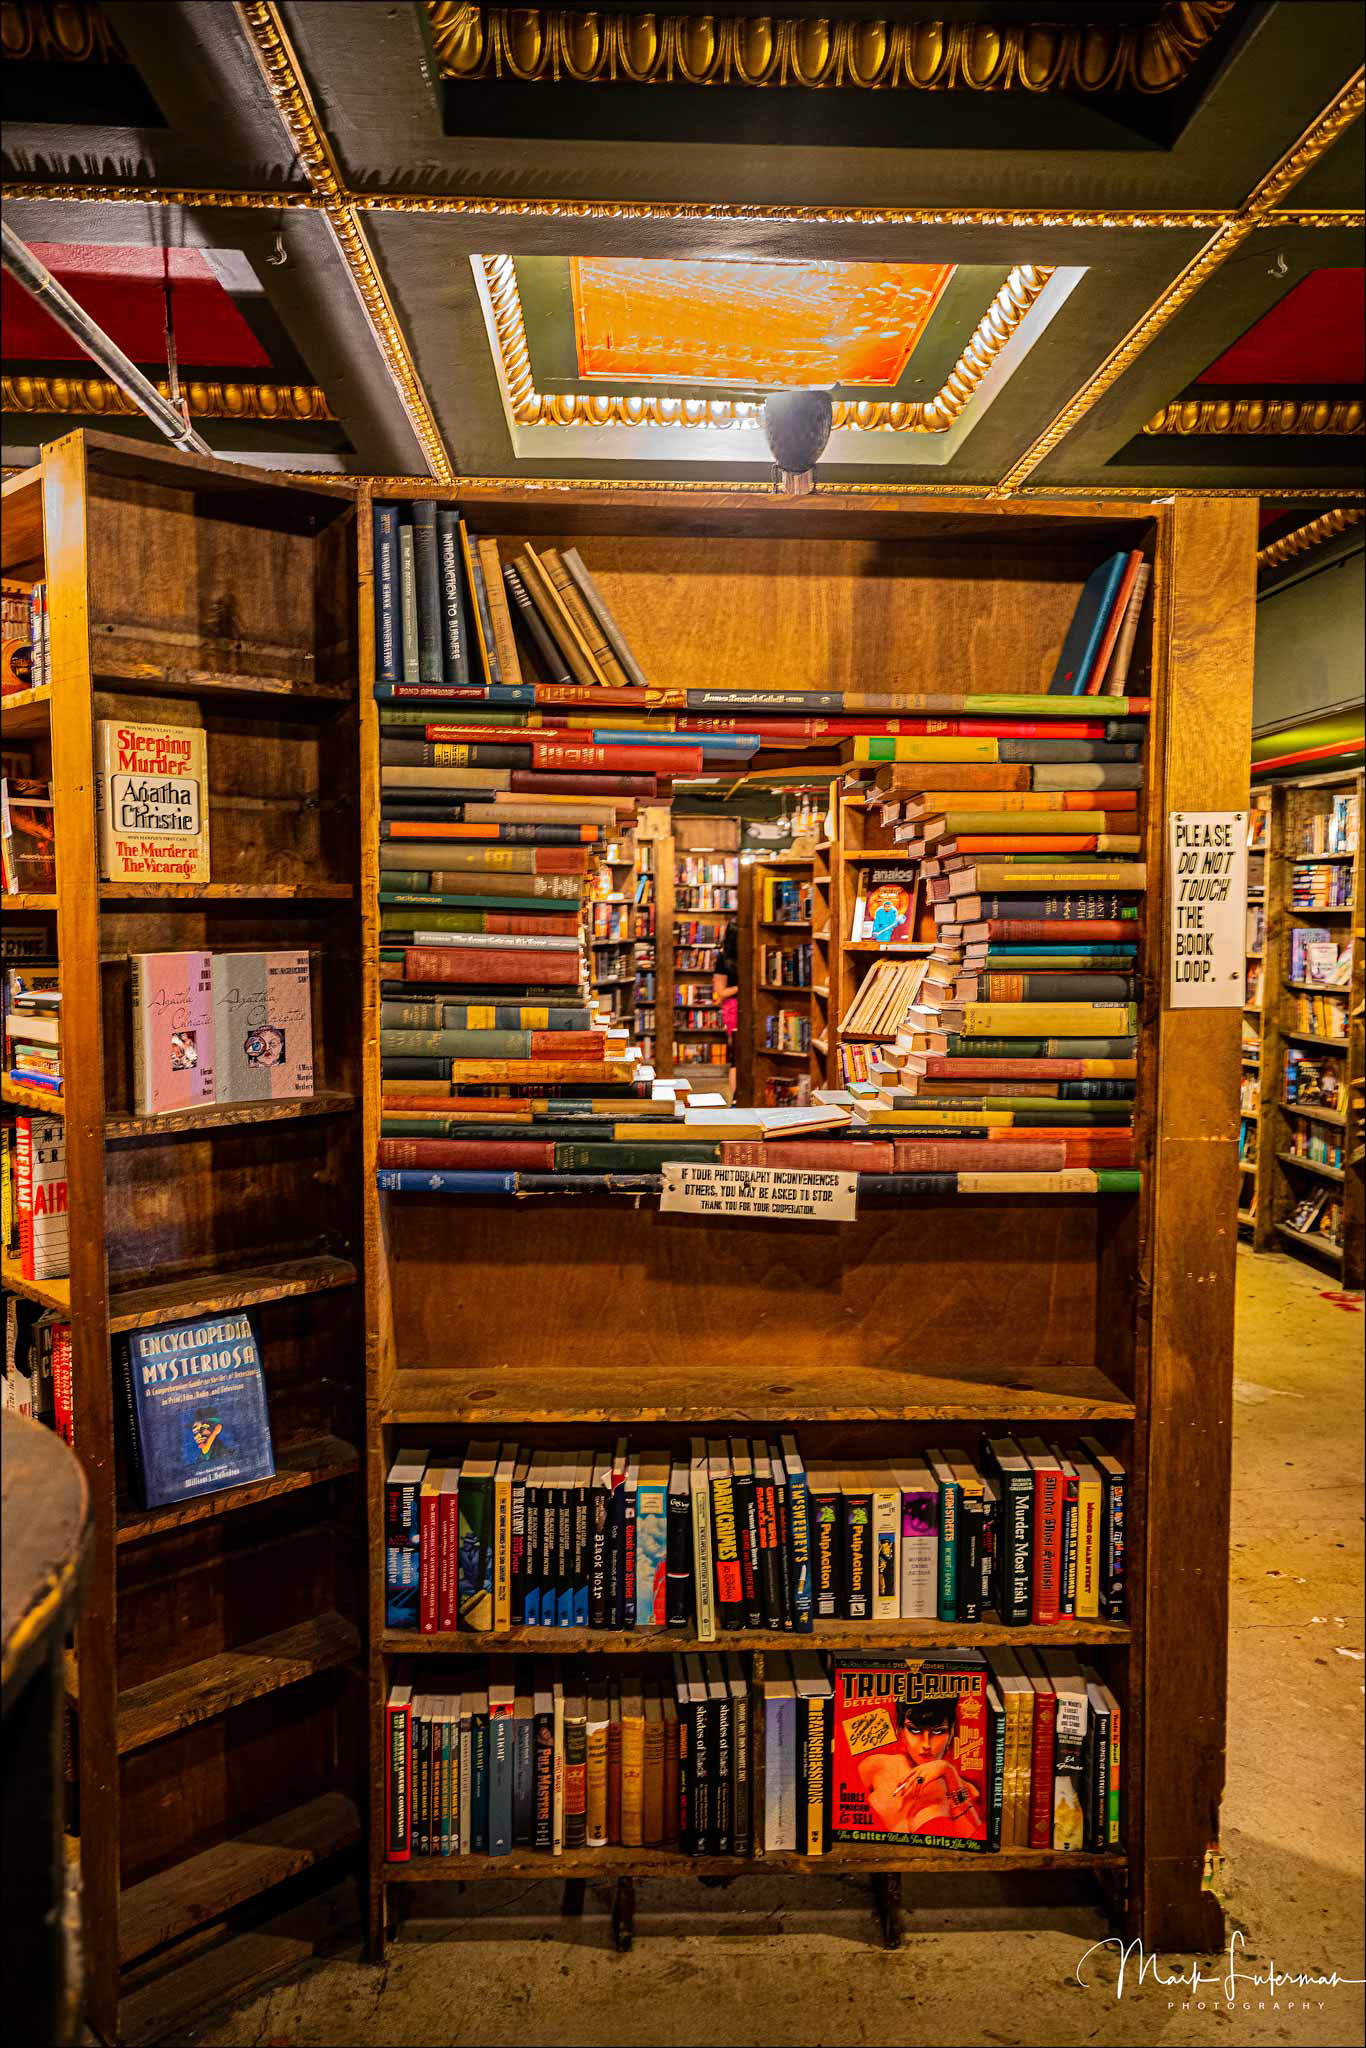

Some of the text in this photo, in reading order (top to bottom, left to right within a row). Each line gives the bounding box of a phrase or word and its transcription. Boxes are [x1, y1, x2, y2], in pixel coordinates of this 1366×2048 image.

[442, 533, 461, 660] INTRODUCTION TO BUSINESS
[117, 729, 192, 761] Sleeping
[118, 751, 192, 776] Murder
[121, 778, 192, 807] Agatha
[122, 803, 193, 830] Christie
[1176, 824, 1233, 847] PLEASE
[115, 841, 138, 857] The
[140, 842, 187, 859] Murder
[1177, 851, 1236, 875] DO NOT
[122, 857, 197, 880] The Vicarage
[872, 867, 913, 882] analog
[1179, 878, 1231, 902] TOUCH
[1176, 906, 1204, 929] THE
[1176, 933, 1214, 956] BOOK
[1175, 960, 1216, 983] LOOP.
[148, 987, 193, 1015] Agatha
[217, 987, 279, 1013] Agatha
[16, 1127, 32, 1212] AIRFRAME
[681, 1168, 839, 1186] IF YOUR PHOTOGRAPHY INCONVENIENCES
[685, 1184, 833, 1202] OTHERS, YOU MAY BE ASKED TO STOP.
[701, 1200, 816, 1215] THANK YOU FOR YOUR COOPERATION.
[139, 1321, 252, 1358] ENCYCLOPEDIA
[142, 1346, 255, 1385] MYSTERIOSA
[185, 1476, 208, 1488] William
[403, 1487, 414, 1527] Hillerman
[713, 1478, 738, 1560] DARK CRIMES
[766, 1487, 777, 1548] GRIFTERS
[1086, 1502, 1095, 1533] MURDER
[944, 1510, 954, 1542] STREETS
[1042, 1477, 1056, 1590] Murder Most Scottish
[1070, 1506, 1078, 1538] MURDER
[593, 1534, 604, 1568] Black
[1013, 1496, 1029, 1604] Murder Most Irish
[1086, 1534, 1092, 1544] ON
[388, 1547, 400, 1584] Detective
[402, 1547, 415, 1585] American
[625, 1525, 635, 1599] Classic Crime Stories
[1069, 1549, 1076, 1560] MY
[593, 1572, 604, 1599] Noir
[1067, 1562, 1076, 1598] BUSINESS
[1084, 1566, 1092, 1593] STREET
[842, 1671, 982, 1704] TRUE CRIME
[844, 1696, 906, 1708] DETECTIVE
[696, 1705, 707, 1739] shades
[719, 1705, 730, 1738] shades
[996, 1718, 1005, 1733] THE
[696, 1740, 707, 1750] of
[719, 1739, 730, 1749] of
[995, 1738, 1005, 1774] VICIOUS
[536, 1750, 552, 1820] PULP MASTERS
[840, 1782, 865, 1803] GIRLS
[993, 1777, 1003, 1808] CIRCLE
[852, 1813, 873, 1825] SELL
[852, 1831, 887, 1841] Gutter
[925, 1836, 950, 1847] Girls
